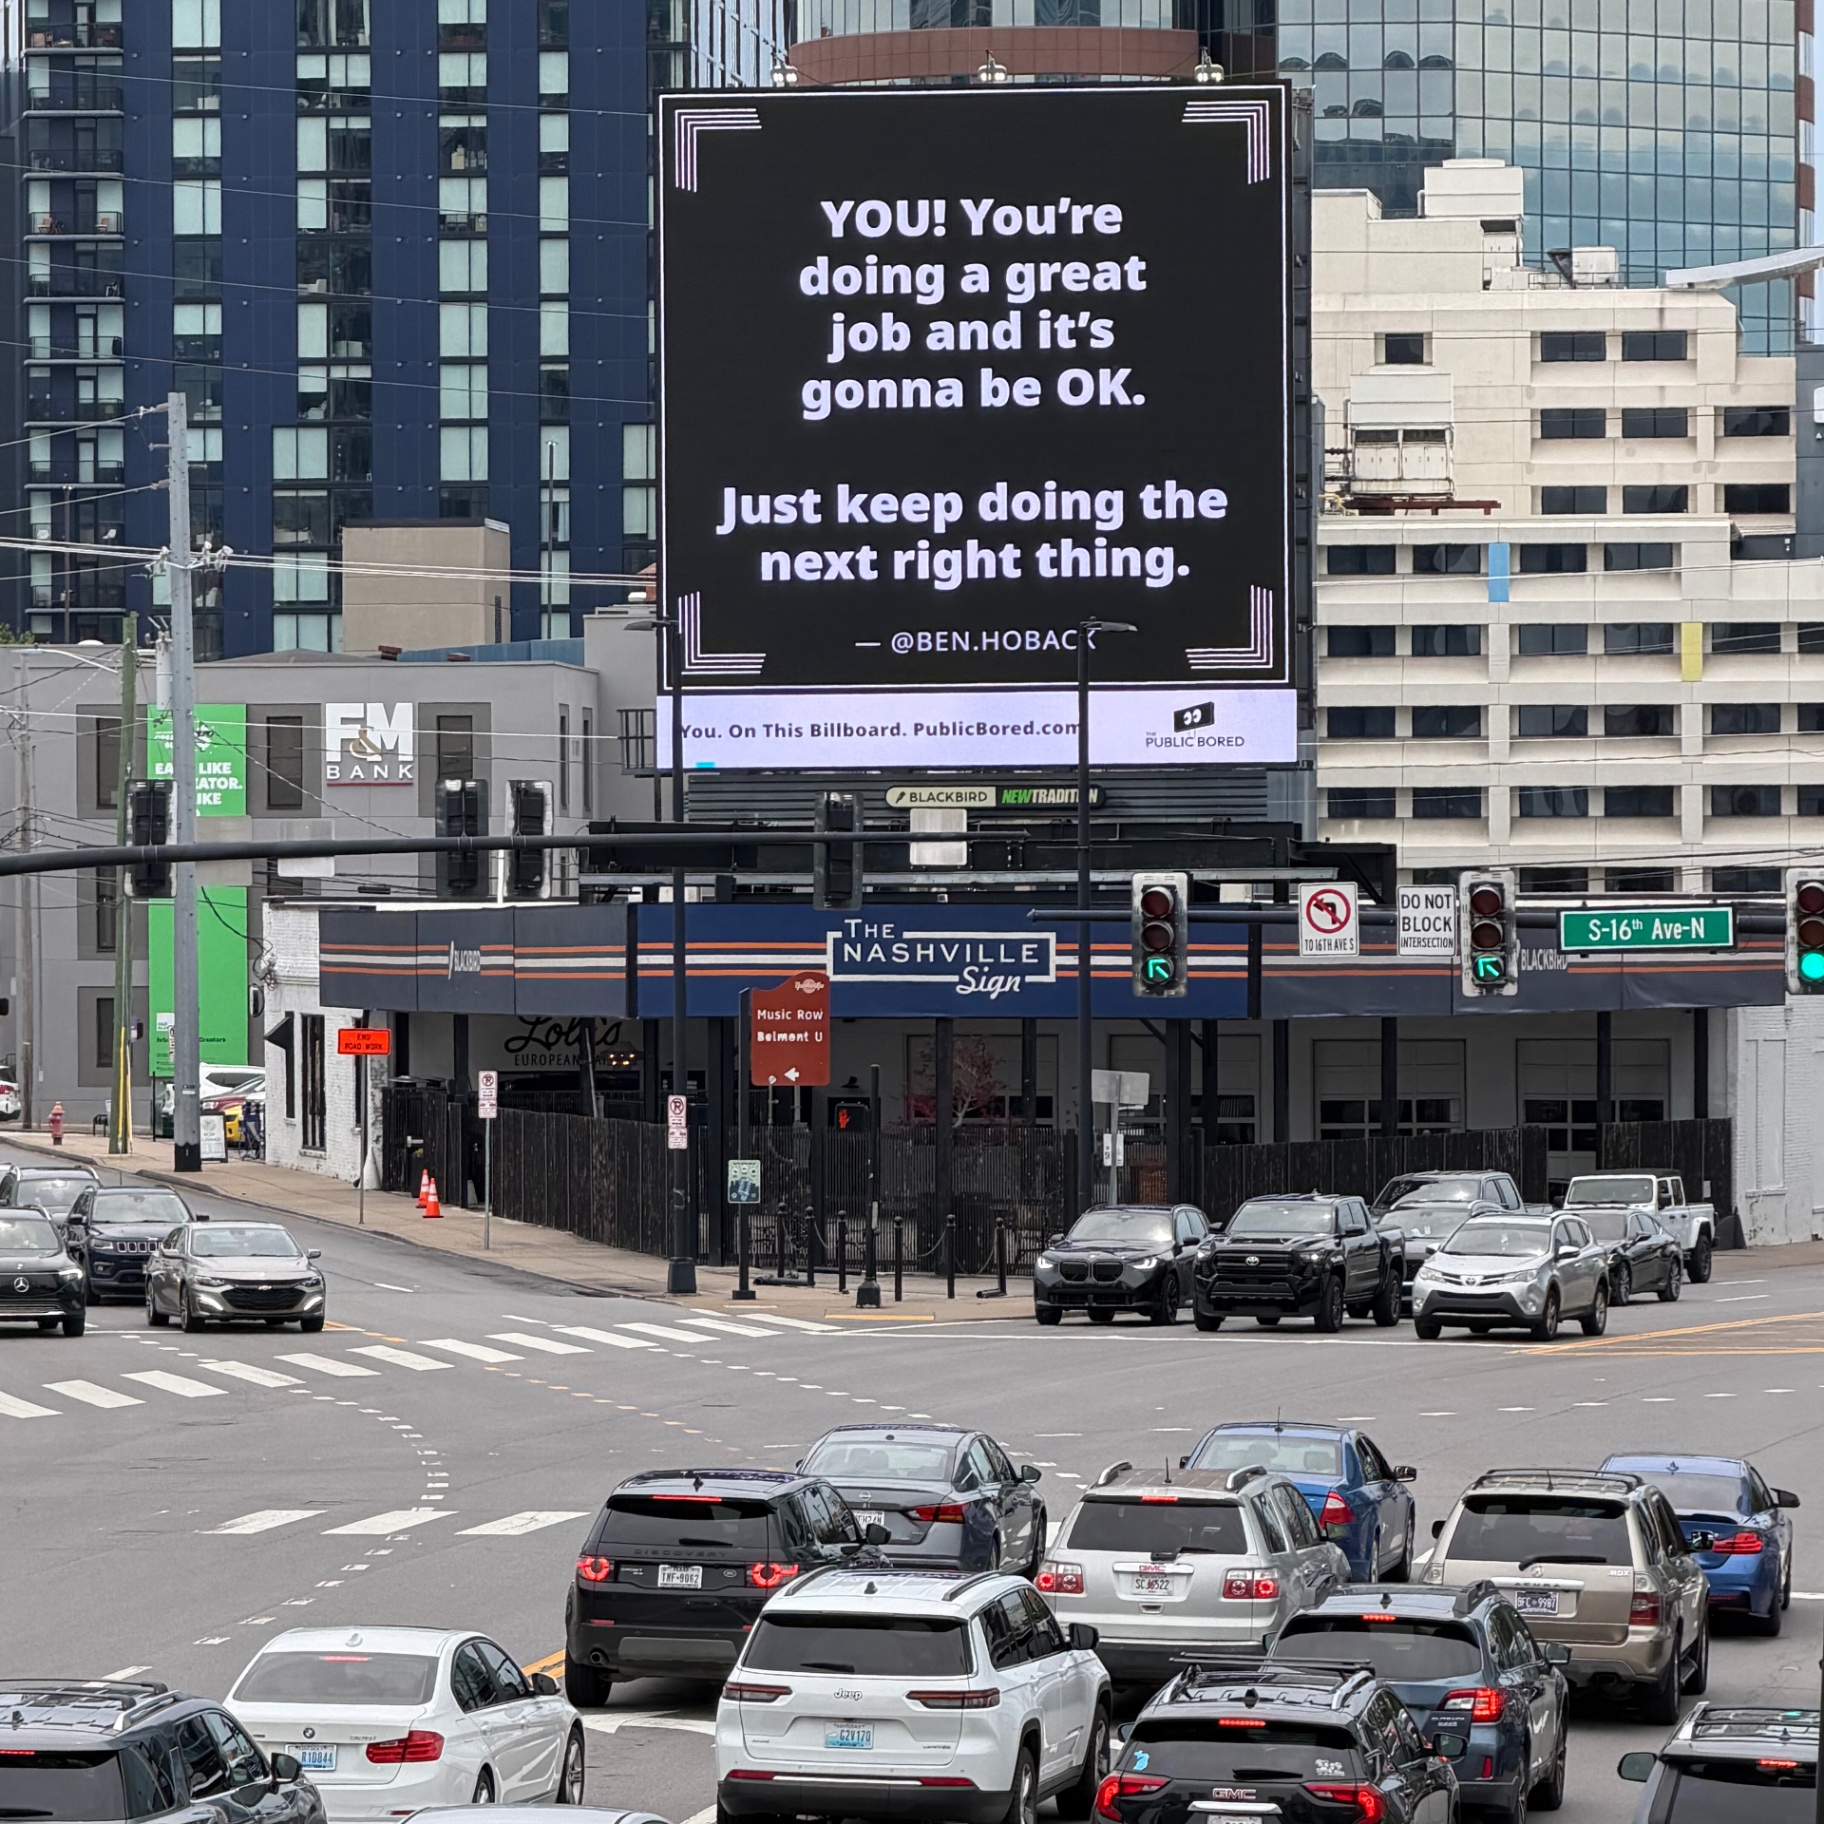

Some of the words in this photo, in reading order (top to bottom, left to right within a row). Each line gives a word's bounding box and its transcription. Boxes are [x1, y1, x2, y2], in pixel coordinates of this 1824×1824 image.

[820, 199, 946, 238] YOU!
[960, 197, 1122, 237] You’re
[799, 255, 945, 305] doing
[960, 264, 990, 294] a
[1006, 256, 1147, 303] great
[827, 311, 911, 363] job
[926, 310, 1022, 351] and
[1039, 309, 1115, 350] it’s
[801, 377, 964, 420] gonna
[980, 367, 1042, 408] be
[1057, 367, 1146, 407] OK.
[715, 486, 822, 535] Just
[836, 483, 964, 533] keep
[977, 481, 1124, 531] doing
[1139, 479, 1228, 520] the
[760, 545, 879, 582] next
[893, 539, 1022, 590] right
[1035, 536, 1190, 588] thing.
[325, 702, 414, 763] F&M
[681, 724, 723, 739] You.
[728, 724, 757, 738] On
[762, 723, 804, 738] This
[810, 722, 907, 738] Billboard.
[913, 720, 1079, 737] PublicBored.com
[1145, 737, 1194, 748] PUBLIC
[1197, 736, 1245, 747] BORED
[198, 762, 232, 775] LIKE
[326, 764, 414, 779] BANK
[195, 777, 243, 790] ATOR.
[196, 792, 222, 805] IKE
[909, 791, 988, 803] BLACKBIRD
[1001, 788, 1099, 804] NEWTRADITN
[1400, 894, 1421, 909] DO
[1424, 893, 1452, 909] NOT
[1401, 916, 1453, 933] BLOCK
[1588, 917, 1643, 941] S-16th
[1651, 916, 1705, 940] Ave-N
[1304, 938, 1314, 952] TO
[1315, 938, 1333, 952] 16TH
[1333, 938, 1348, 951] AVE
[1349, 938, 1355, 951] S
[1400, 937, 1454, 949] INTERSECTION
[454, 949, 481, 972] BLACKBIRD
[843, 942, 1039, 964] NASHVILLE
[1520, 948, 1569, 972] BLACKBIRD
[955, 965, 1021, 1000] Sign
[757, 1008, 793, 1020] Music
[797, 1009, 824, 1020] Row
[356, 1033, 371, 1041] END
[757, 1030, 809, 1042] Belmont
[814, 1031, 823, 1042] U
[344, 1042, 362, 1051] ROAD
[365, 1042, 383, 1051] WORK
[514, 1053, 580, 1067] EUROPEAN
[633, 1548, 728, 1558] DISCOVERY
[1607, 1569, 1630, 1577] MDX
[833, 1688, 863, 1700] Jeep
[1212, 1787, 1257, 1800] GMC
